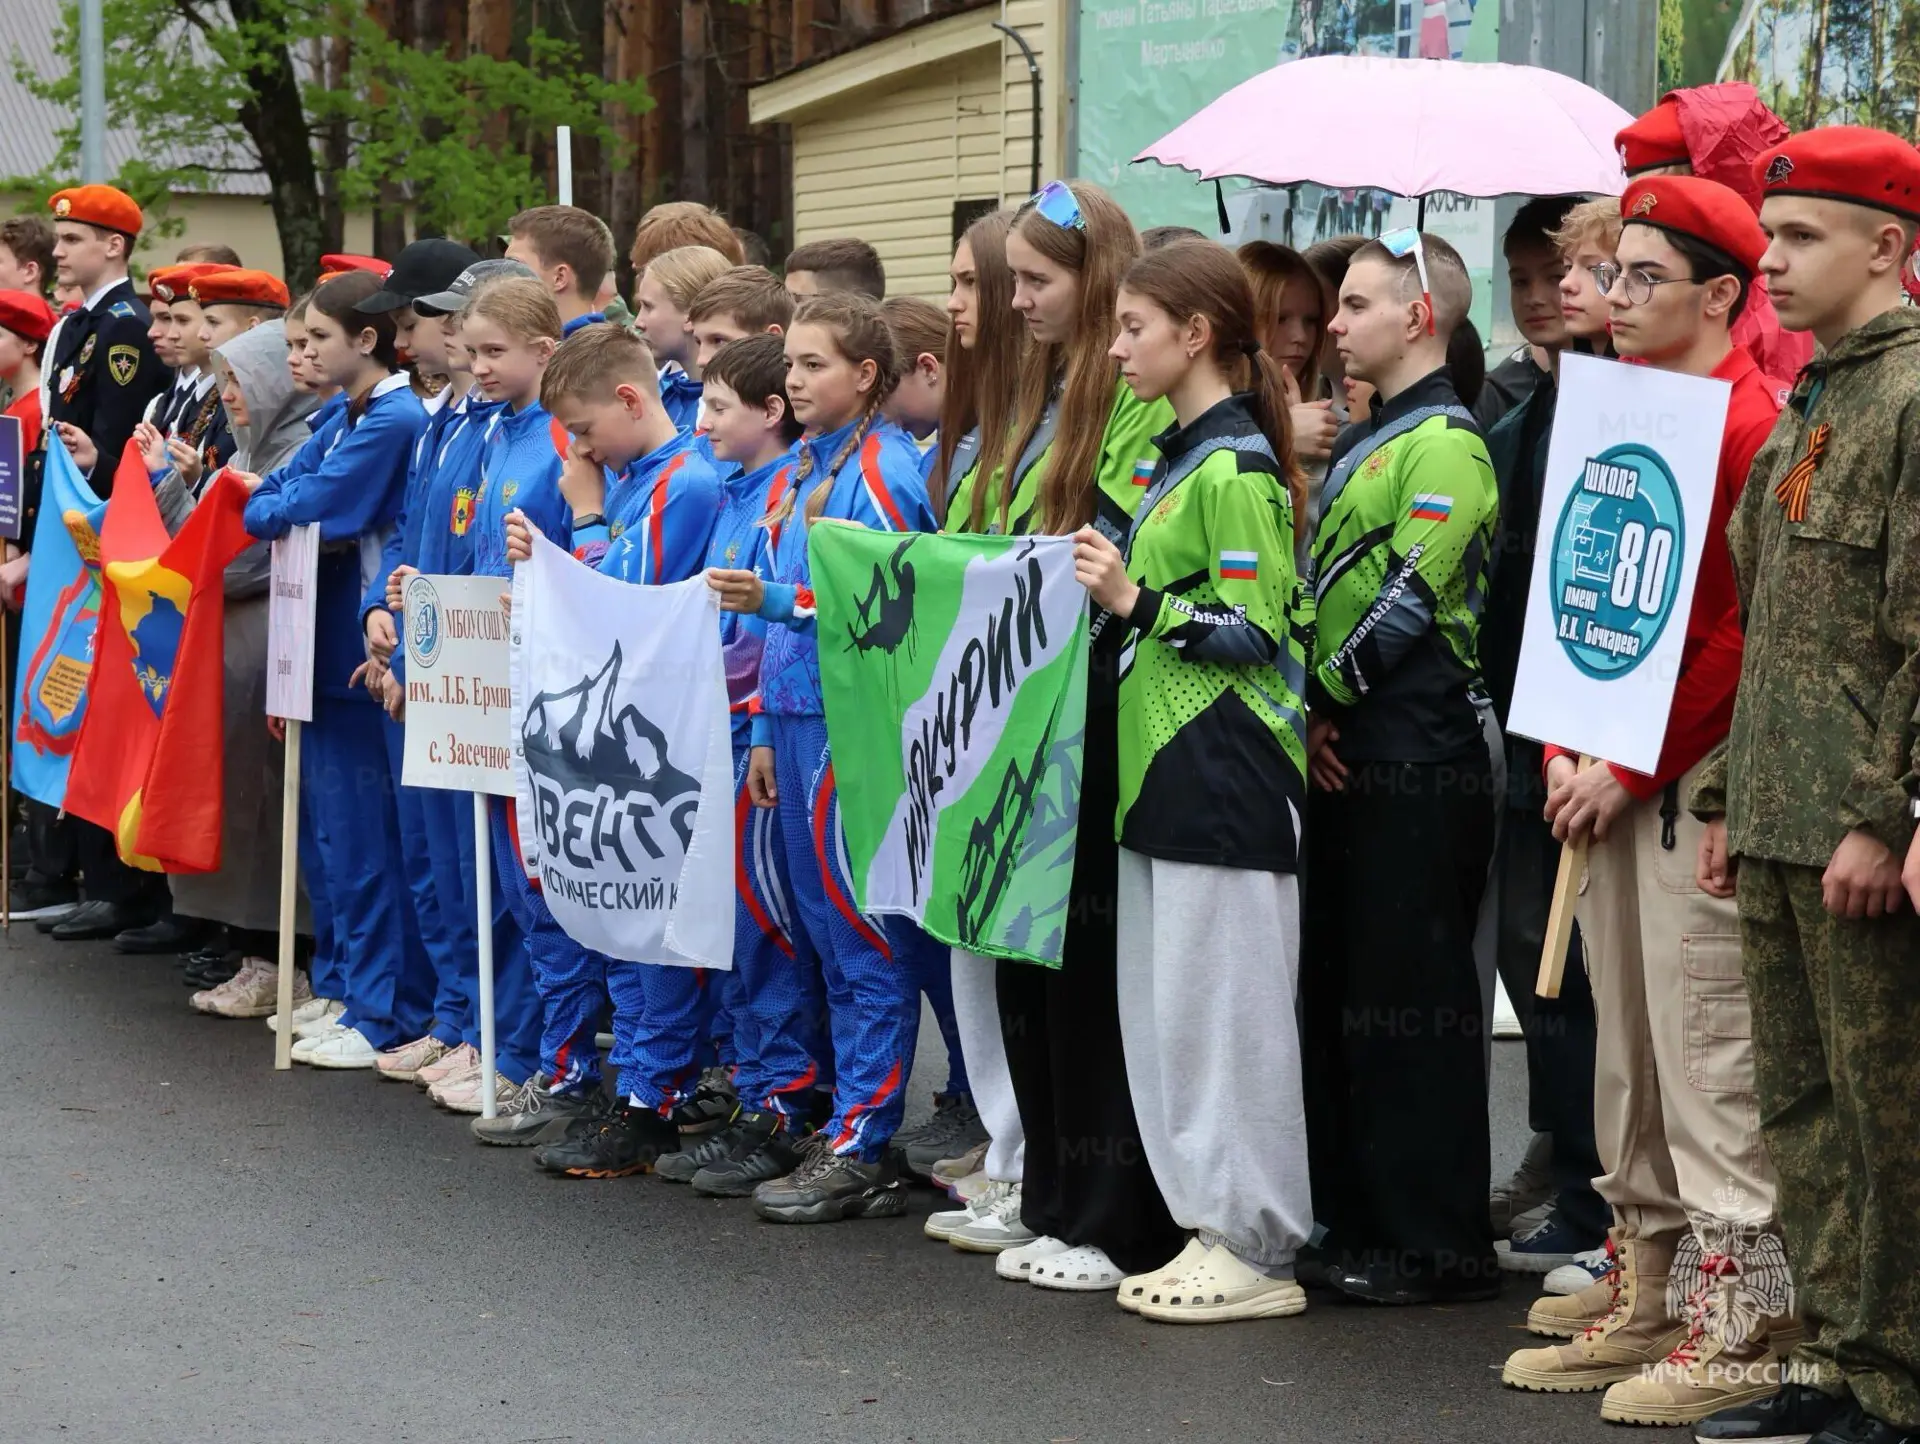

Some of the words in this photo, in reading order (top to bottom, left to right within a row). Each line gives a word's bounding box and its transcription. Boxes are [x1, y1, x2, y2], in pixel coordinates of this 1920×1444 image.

[1611, 521, 1672, 615] 80
[1584, 620, 1640, 657] Бочкарева
[409, 682, 435, 703] им.
[439, 675, 469, 705] Л.Б.
[430, 740, 442, 763] с.
[446, 732, 511, 770] Засечное
